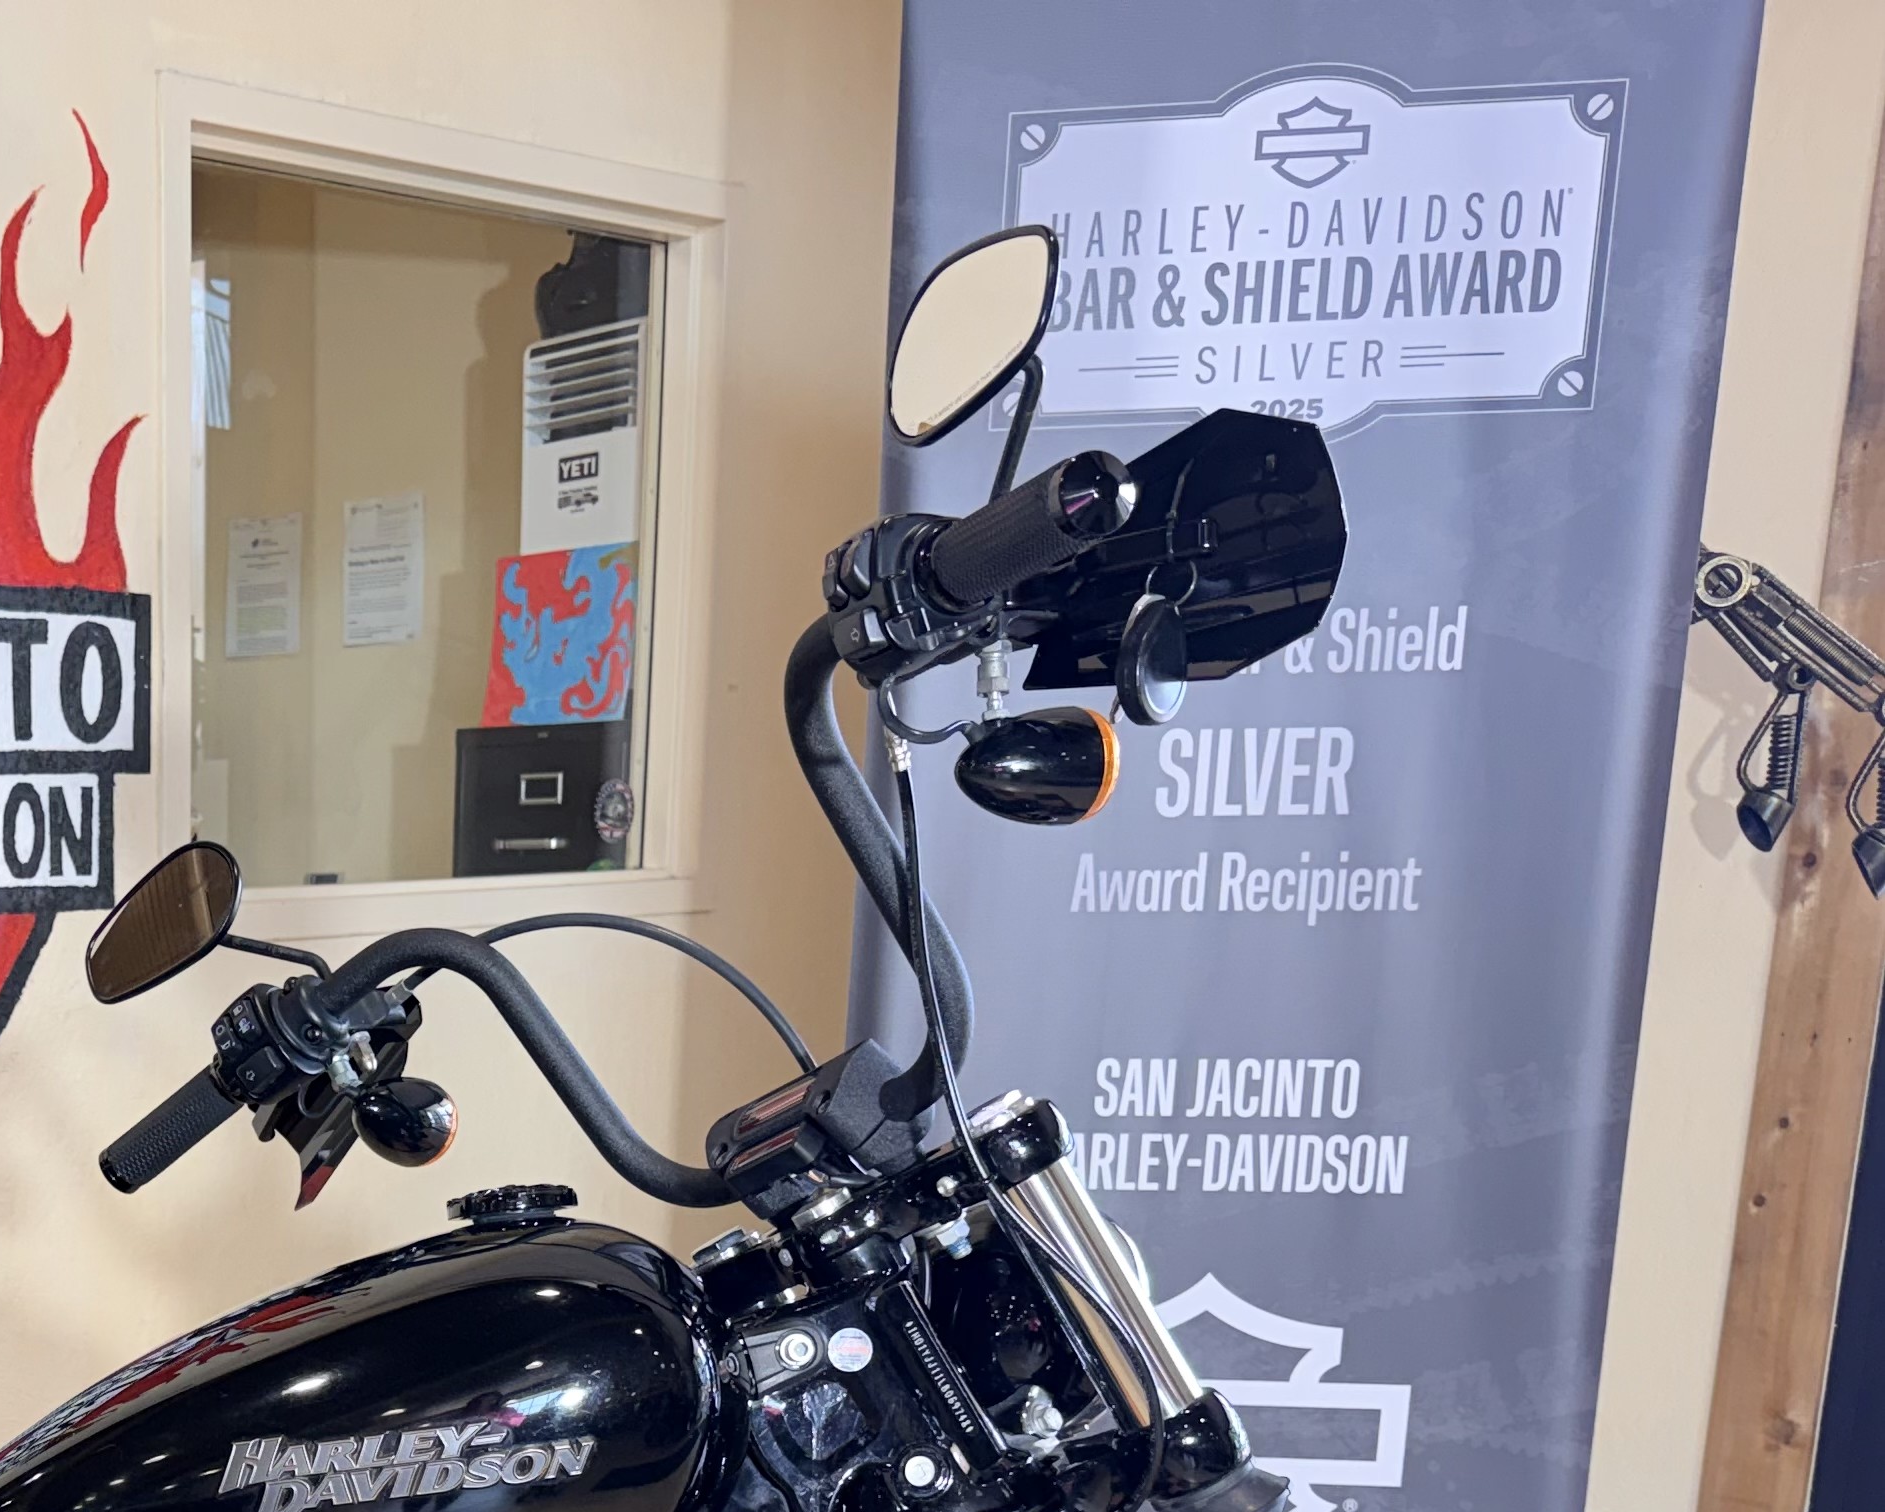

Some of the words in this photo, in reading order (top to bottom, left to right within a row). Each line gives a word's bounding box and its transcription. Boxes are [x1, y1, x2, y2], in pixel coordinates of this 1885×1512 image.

[1050, 189, 1566, 258] HARLEY-DAVIDSON
[1152, 264, 1185, 328] &
[1201, 256, 1374, 326] SHIELD
[1383, 248, 1563, 318] AWARD
[1195, 339, 1385, 384] SILVER
[1250, 398, 1324, 420] 2025
[560, 456, 597, 480] YETI
[1327, 606, 1468, 673] Shield
[1155, 727, 1354, 818] SILVER
[1070, 852, 1208, 913] Award
[1219, 851, 1422, 927] Recipient
[1094, 1058, 1177, 1117] SAN
[1186, 1058, 1360, 1119] JACINTO
[1069, 1132, 1409, 1194] ARLEY-DAVIDSON
